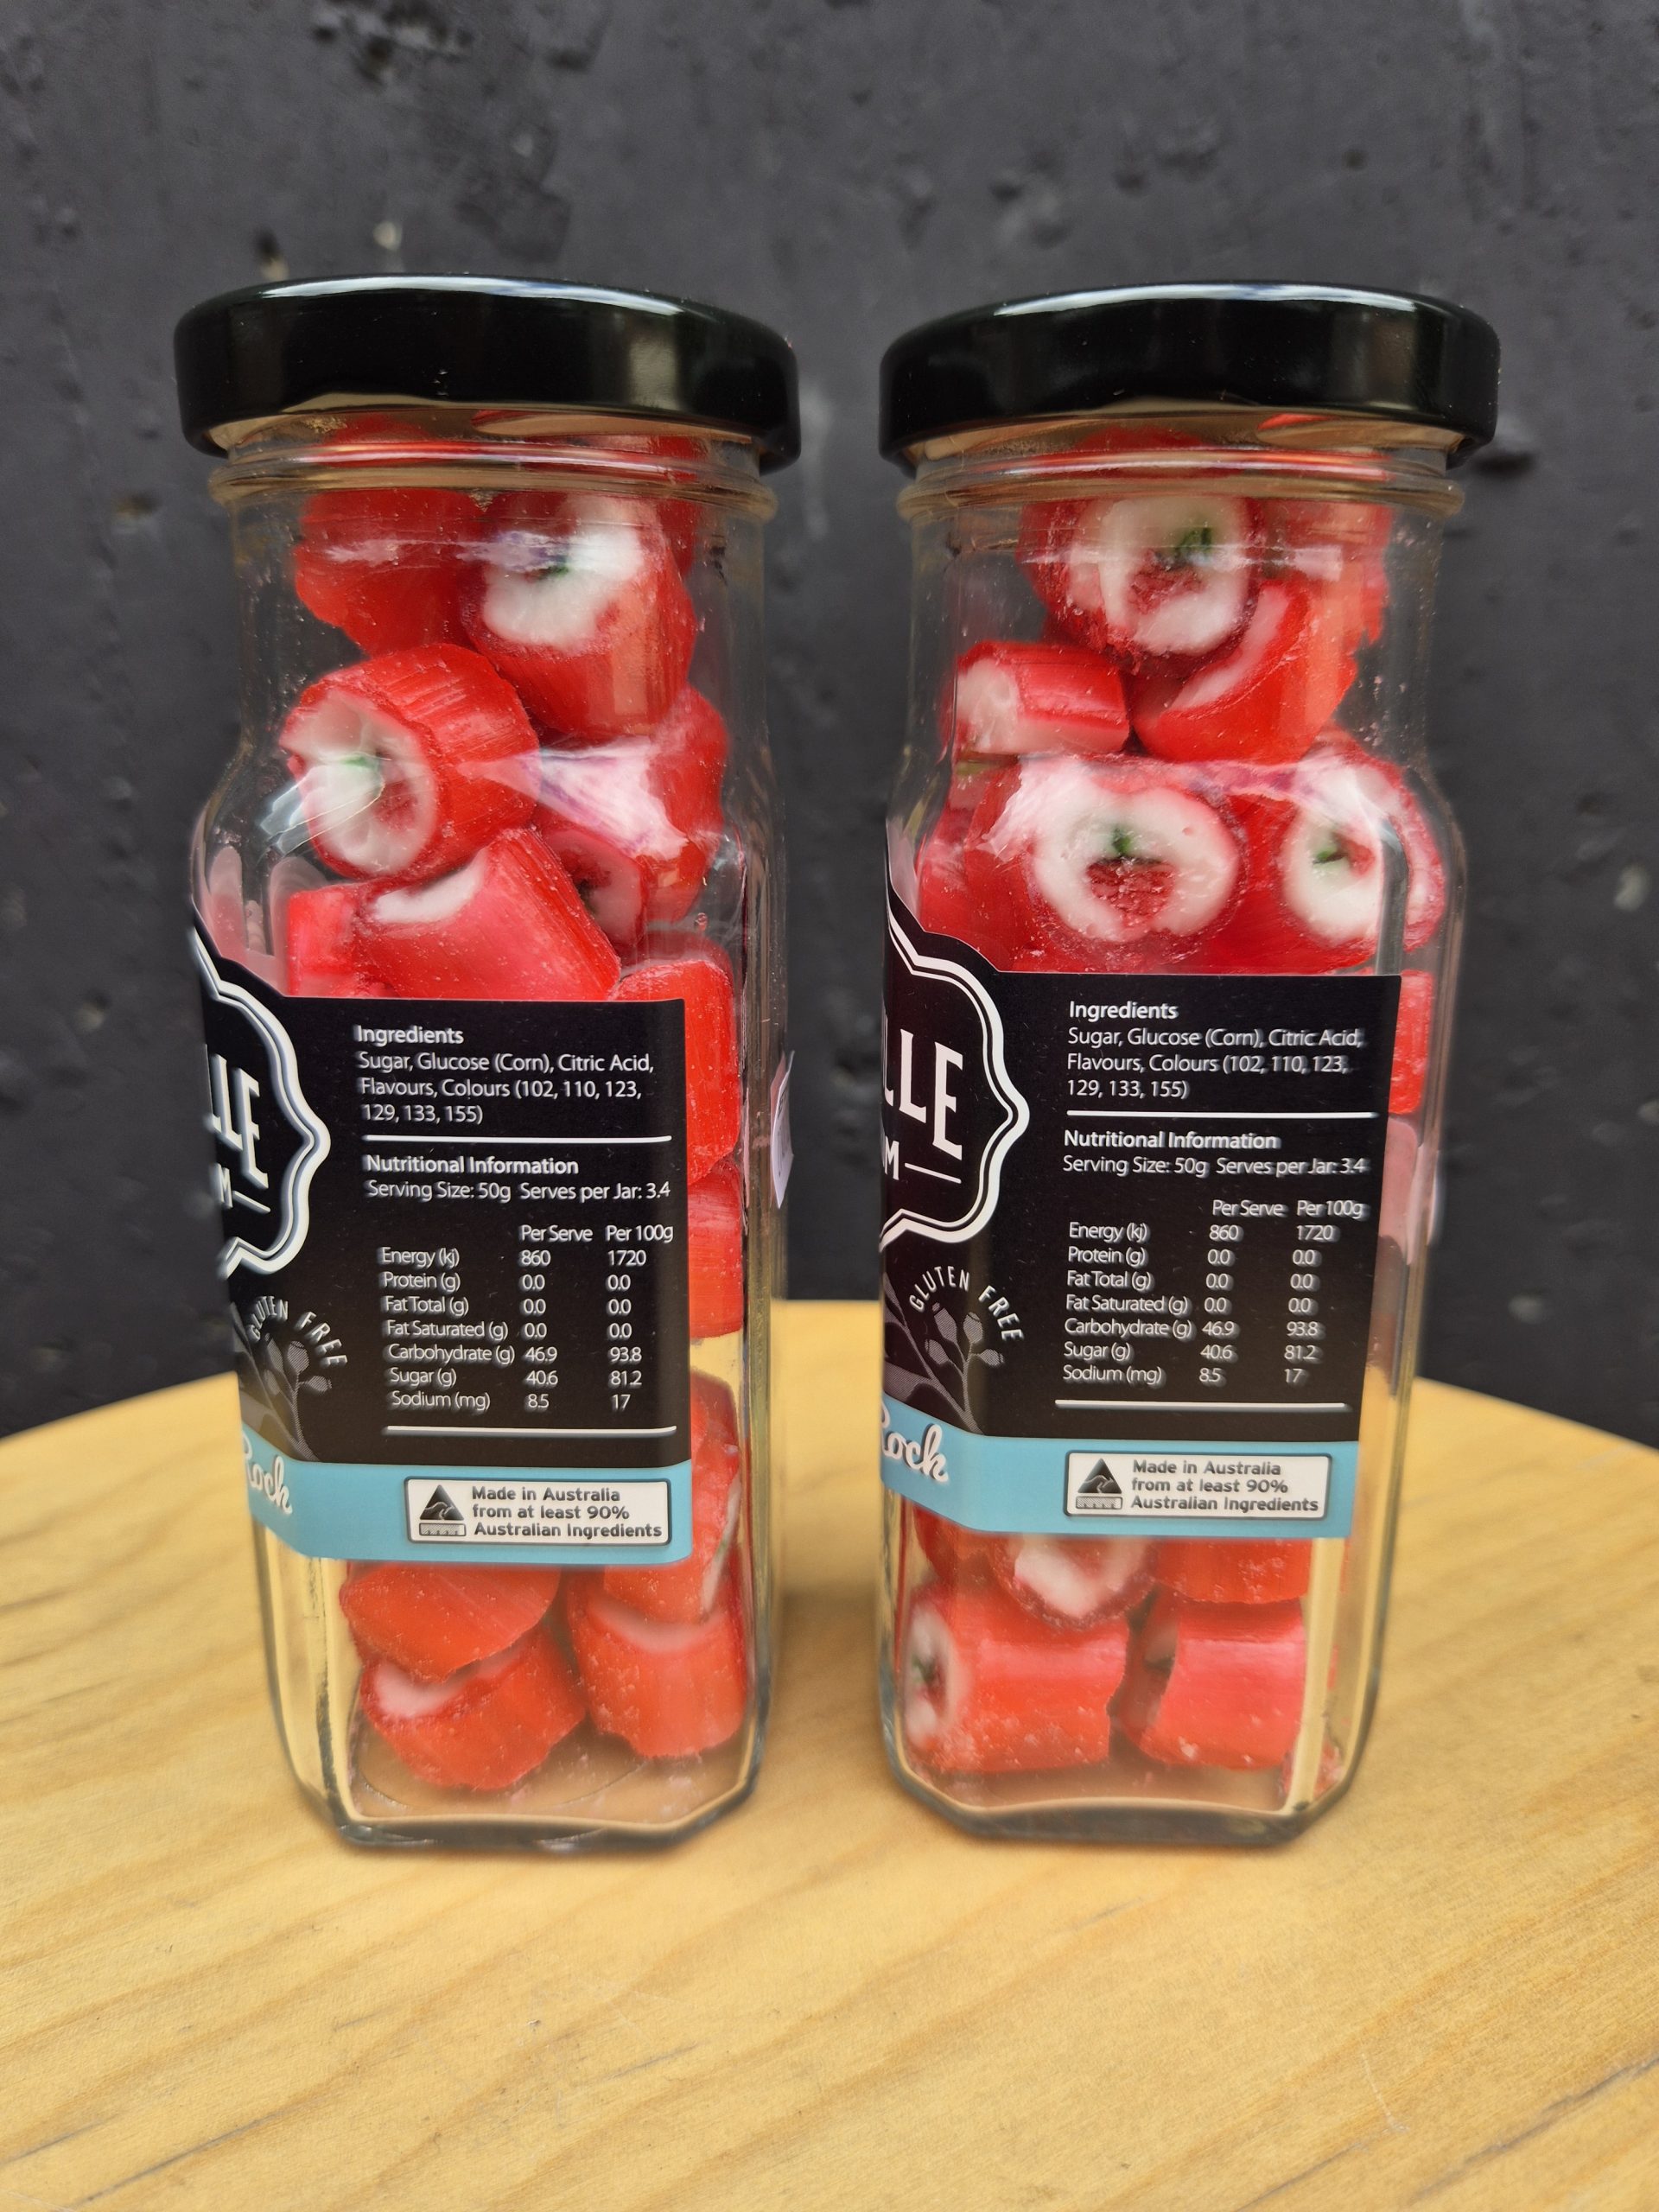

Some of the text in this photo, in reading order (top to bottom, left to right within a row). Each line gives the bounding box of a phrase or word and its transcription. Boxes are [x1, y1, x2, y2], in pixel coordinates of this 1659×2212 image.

[1069, 1001, 1178, 1022] Ingredients
[355, 1026, 464, 1046] Ingredients
[1068, 1027, 1363, 1048] Sugar, Glucose (Corn), Citric Acid,
[358, 1052, 654, 1074] Sugar, Glucose (Corn), Citric Acid,
[1067, 1053, 1350, 1074] Flavours, Colours (102, 110, 123,
[359, 1078, 642, 1100] Flavours, Colours (102, 110, 123,
[1067, 1080, 1190, 1100] 129, 133, 155)
[362, 1104, 483, 1124] 129, 133, 155)
[1064, 1130, 1281, 1149] Nutritional Information
[365, 1155, 578, 1174] Nutritional Information
[1063, 1156, 1368, 1178] Serving Size: 50g Serves per Jar: 3.4
[367, 1180, 671, 1203] Serving Size: 50g Serves per Jar: 3.4
[1212, 1200, 1364, 1219] Per Serve Per 100g
[519, 1225, 673, 1243] Per Serve Per 100g
[1069, 1222, 1333, 1243] Energy (kj) 860 1720
[380, 1248, 646, 1267] Energy (kj) 860 1720
[1068, 1246, 1316, 1267] Protein (g) 0.0 0.0
[382, 1272, 631, 1292] Protein (g) 0.0 0.0
[1067, 1270, 1313, 1291] Fat Total (g) 0.0 0.0
[384, 1296, 631, 1316] Fat Total (g) 0.0 0.0
[909, 1265, 1025, 1341] GLUTEN FREE
[1066, 1295, 1312, 1315] Fat Saturated (g) 0.0 0.0
[247, 1296, 347, 1367] GLUTEN FREE
[386, 1320, 632, 1341] Fat Saturated (g) 0.0 0.0
[1065, 1319, 1319, 1339] Carbohydrate (g) 46.9 93.8
[388, 1344, 642, 1366] Carbohydrate (g) 46.9 93.8
[1064, 1342, 1316, 1363] Sugar (g) 40.6 81.2
[389, 1368, 642, 1389] Sugar (g) 40.6 81.2
[1064, 1366, 1304, 1386] Sodium (mg) 8.5 17
[391, 1391, 630, 1412] Sodium (mg) 8.5 17
[1133, 1459, 1281, 1476] Made in Australia
[473, 1486, 620, 1501] Made in Australia
[1132, 1478, 1288, 1494] from at least 90%
[473, 1504, 629, 1519] from at least 90%
[1131, 1496, 1319, 1514] Australian Ingredients
[474, 1522, 662, 1540] Australian Ingredients
